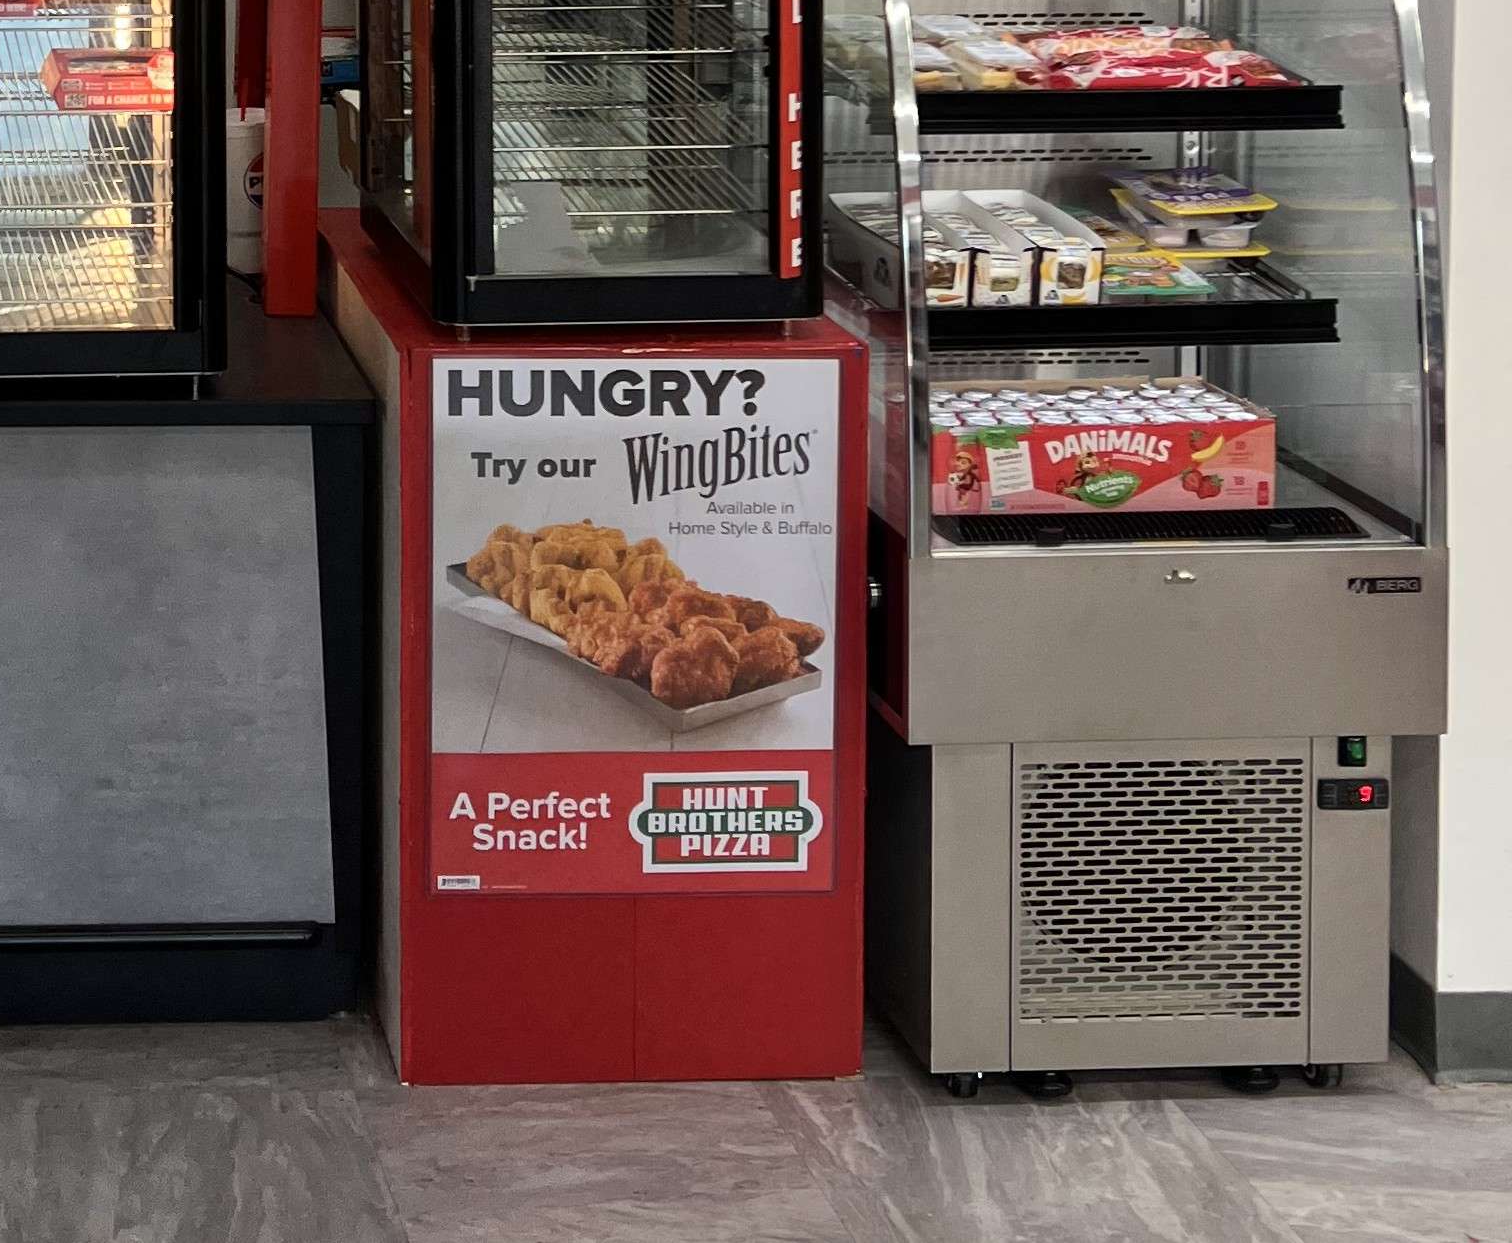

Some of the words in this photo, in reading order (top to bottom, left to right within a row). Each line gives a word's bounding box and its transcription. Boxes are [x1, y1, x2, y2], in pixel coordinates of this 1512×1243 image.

[447, 369, 766, 417] HUNGRY?
[471, 451, 528, 485] Try
[536, 457, 596, 478] our
[706, 501, 776, 515] Available
[780, 501, 795, 515] in
[669, 521, 716, 536] Home
[720, 521, 758, 538] Style
[762, 521, 774, 536] &
[778, 521, 833, 536] Buffalo
[1376, 579, 1418, 591] BERG
[449, 792, 477, 820] A
[488, 791, 611, 820] Perfect
[683, 786, 769, 811] HUNT
[647, 810, 805, 834] BROTHERS
[472, 823, 589, 852] Snack!
[680, 833, 771, 857] PIZZA
